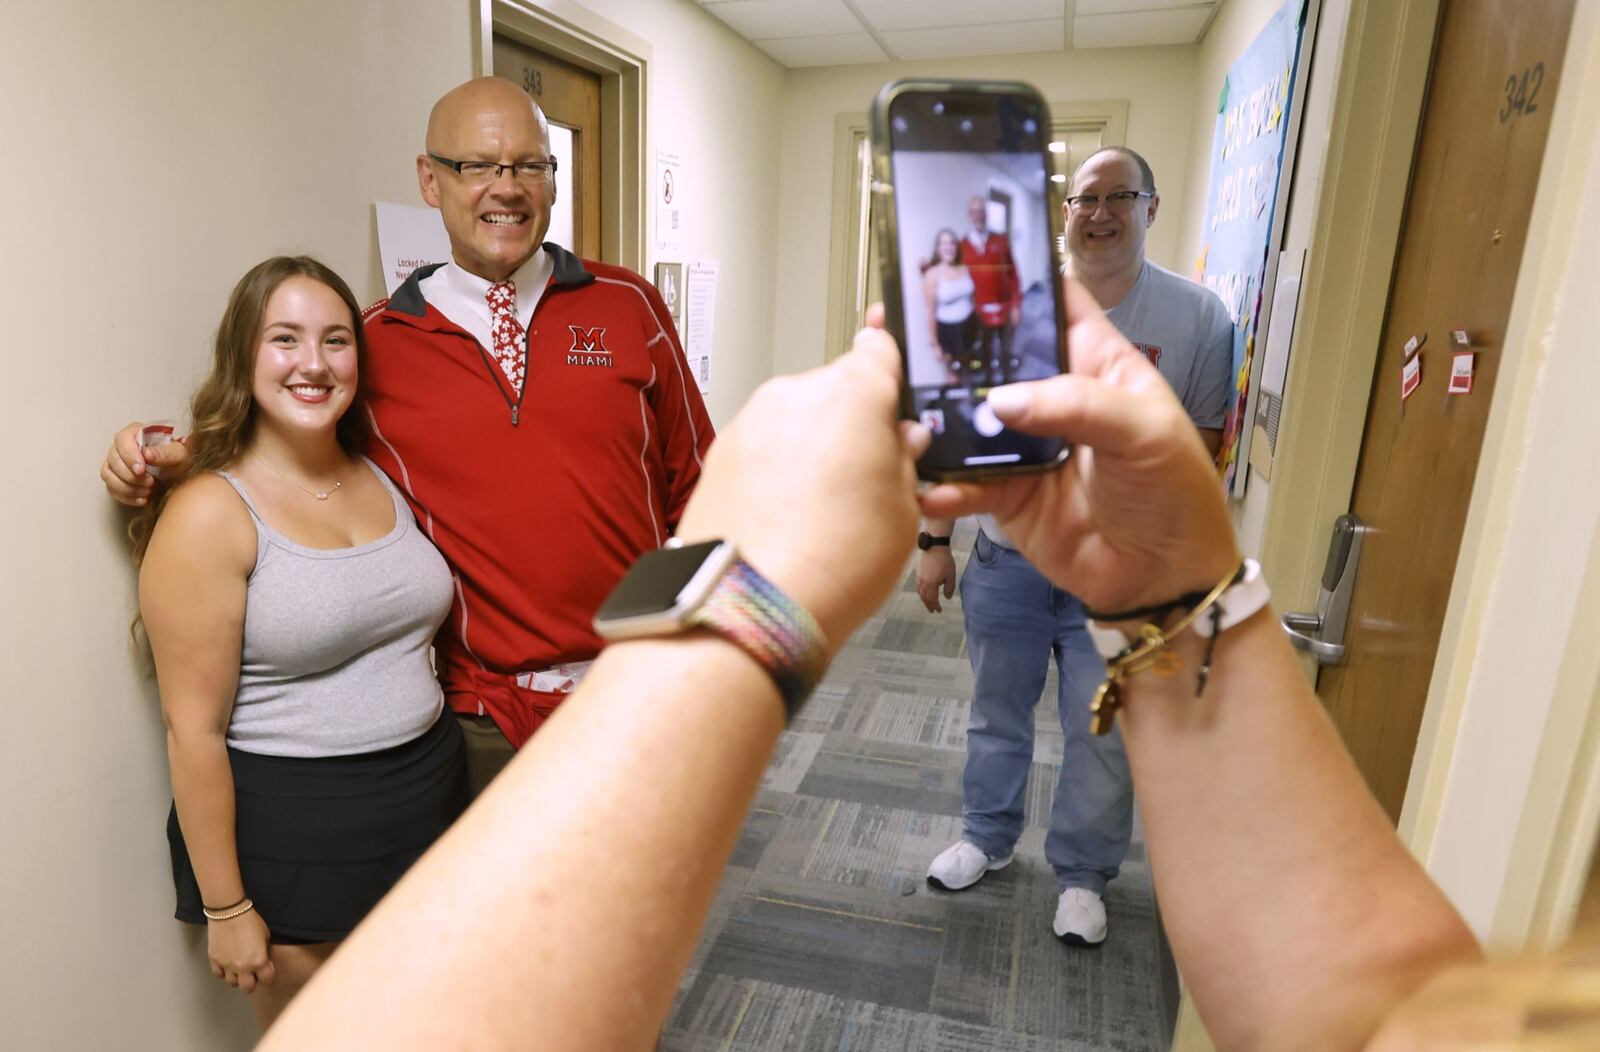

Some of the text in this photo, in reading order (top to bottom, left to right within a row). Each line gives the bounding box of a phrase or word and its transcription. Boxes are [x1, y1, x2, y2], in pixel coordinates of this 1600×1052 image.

[522, 67, 542, 96] 343
[1500, 62, 1544, 124] 342
[397, 258, 419, 268] Locked
[567, 355, 612, 367] MIAMI
